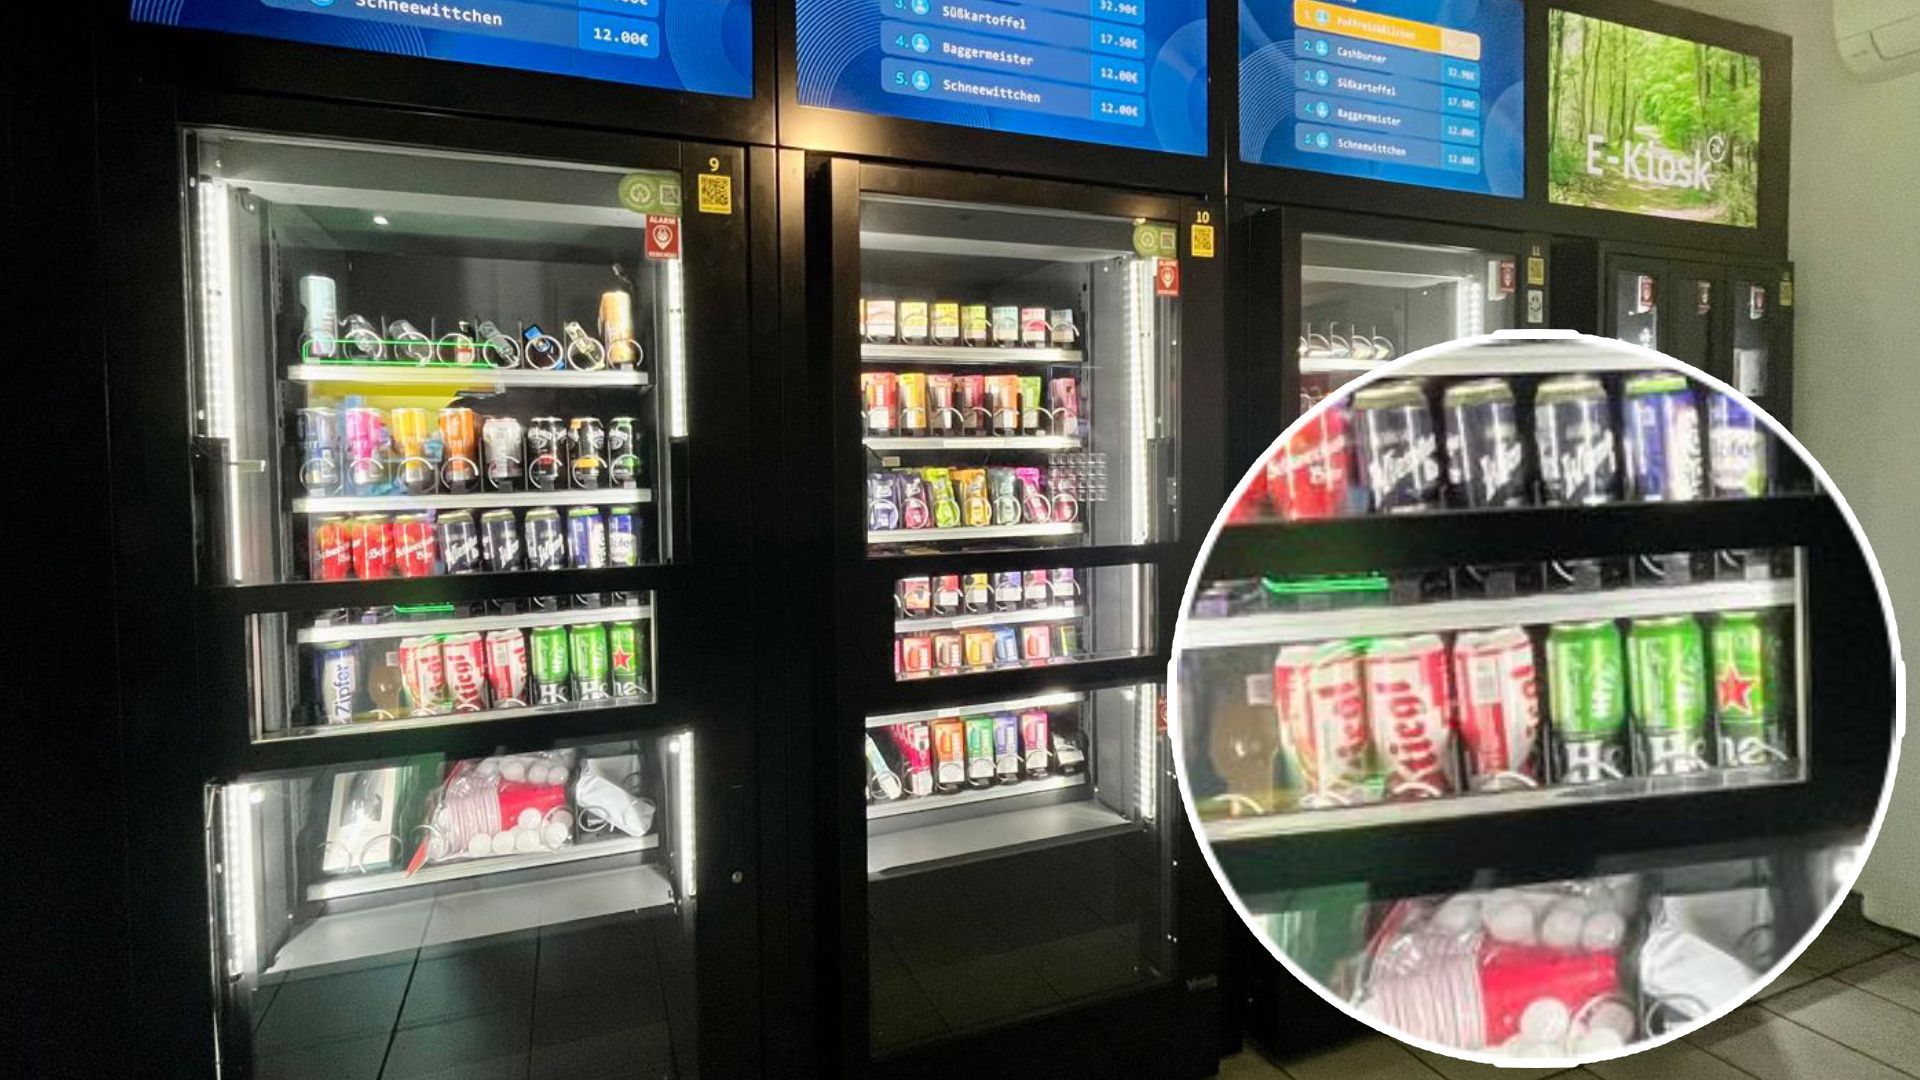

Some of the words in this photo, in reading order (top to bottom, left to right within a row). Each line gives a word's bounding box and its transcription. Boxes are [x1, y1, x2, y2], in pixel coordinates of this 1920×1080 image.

[593, 27, 649, 46] 12.00€
[942, 5, 1027, 31] Süßkartoffel
[1100, 33, 1138, 49] 17.50€
[942, 42, 1034, 67] Baggermeister
[1100, 67, 1138, 84] 12.00€
[1337, 46, 1388, 64] Cashburner
[942, 79, 1041, 104] Schneewittchen
[1100, 102, 1138, 117] 12.00€
[1337, 108, 1401, 127] Baggermeister
[1337, 138, 1407, 157] Schneewittchen
[709, 157, 720, 172] 9
[1587, 134, 1712, 192] E-Kiosk
[649, 215, 676, 225] ALARM
[1196, 211, 1210, 223] 10
[333, 664, 353, 717] Zipfer
